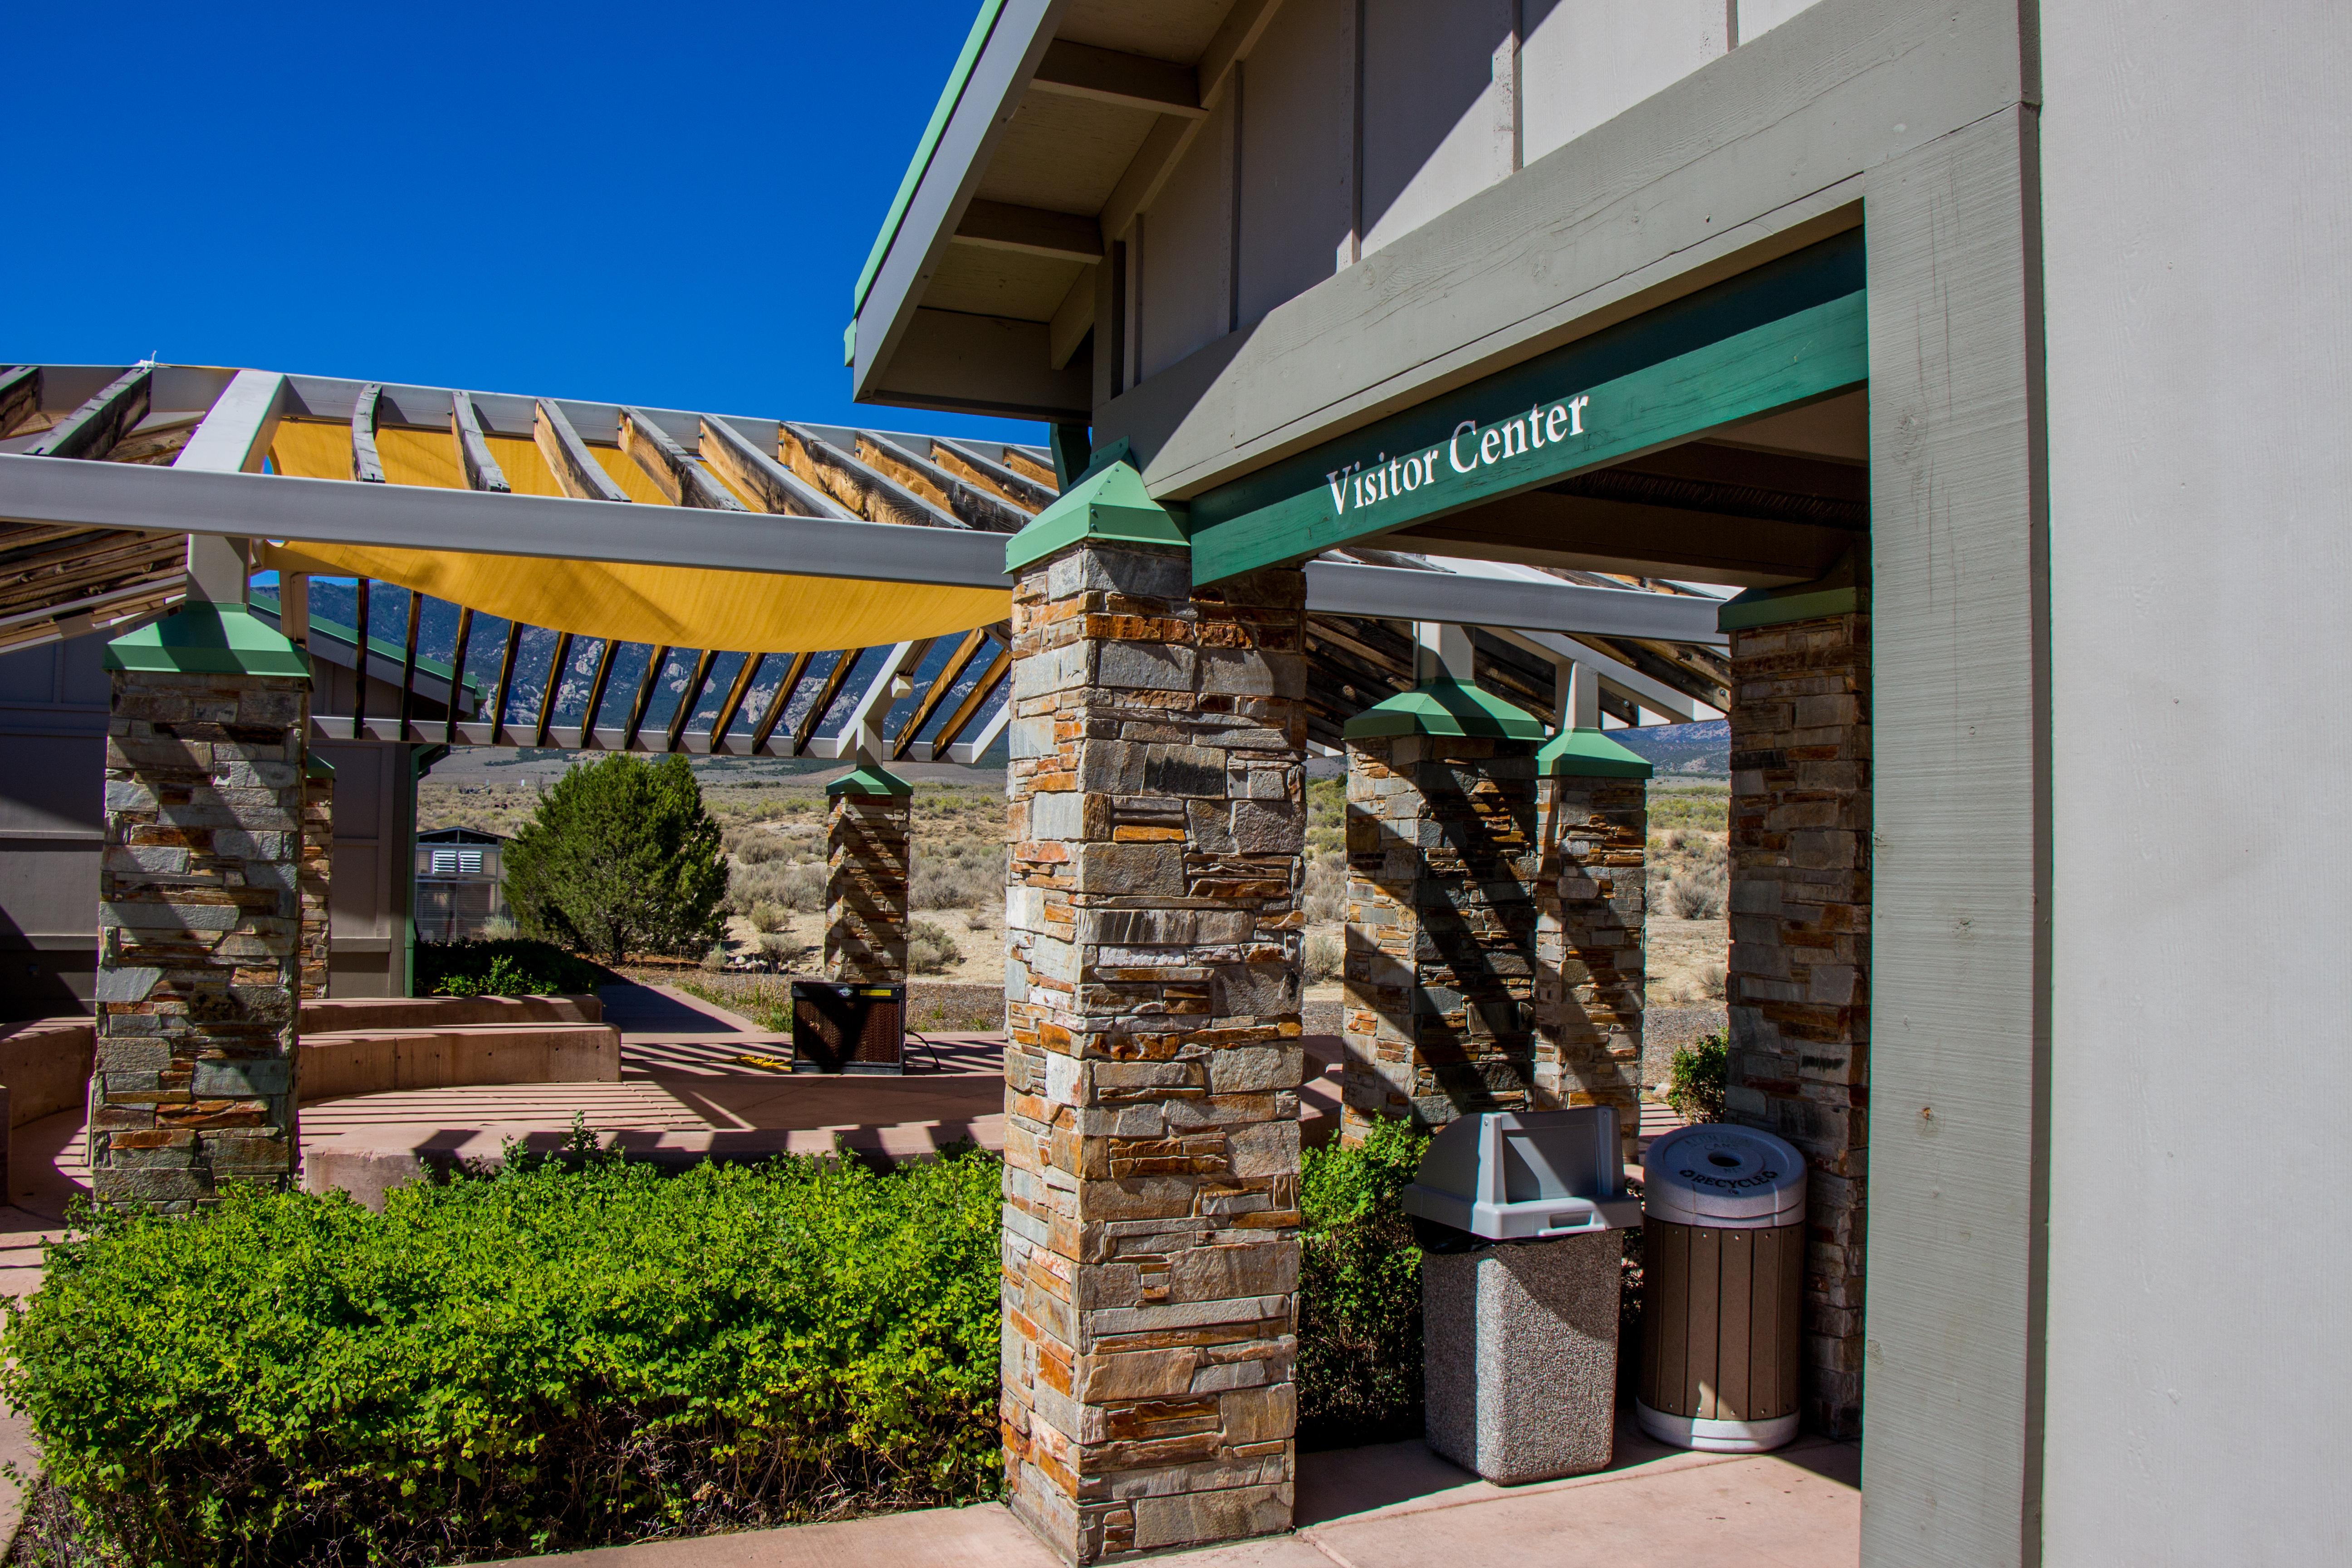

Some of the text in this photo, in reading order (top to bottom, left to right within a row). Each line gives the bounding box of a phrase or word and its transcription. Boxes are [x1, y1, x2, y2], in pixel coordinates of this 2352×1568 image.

[1326, 396, 1589, 515] Visitor Center
[1691, 1174, 1769, 1188] RECYCLE
